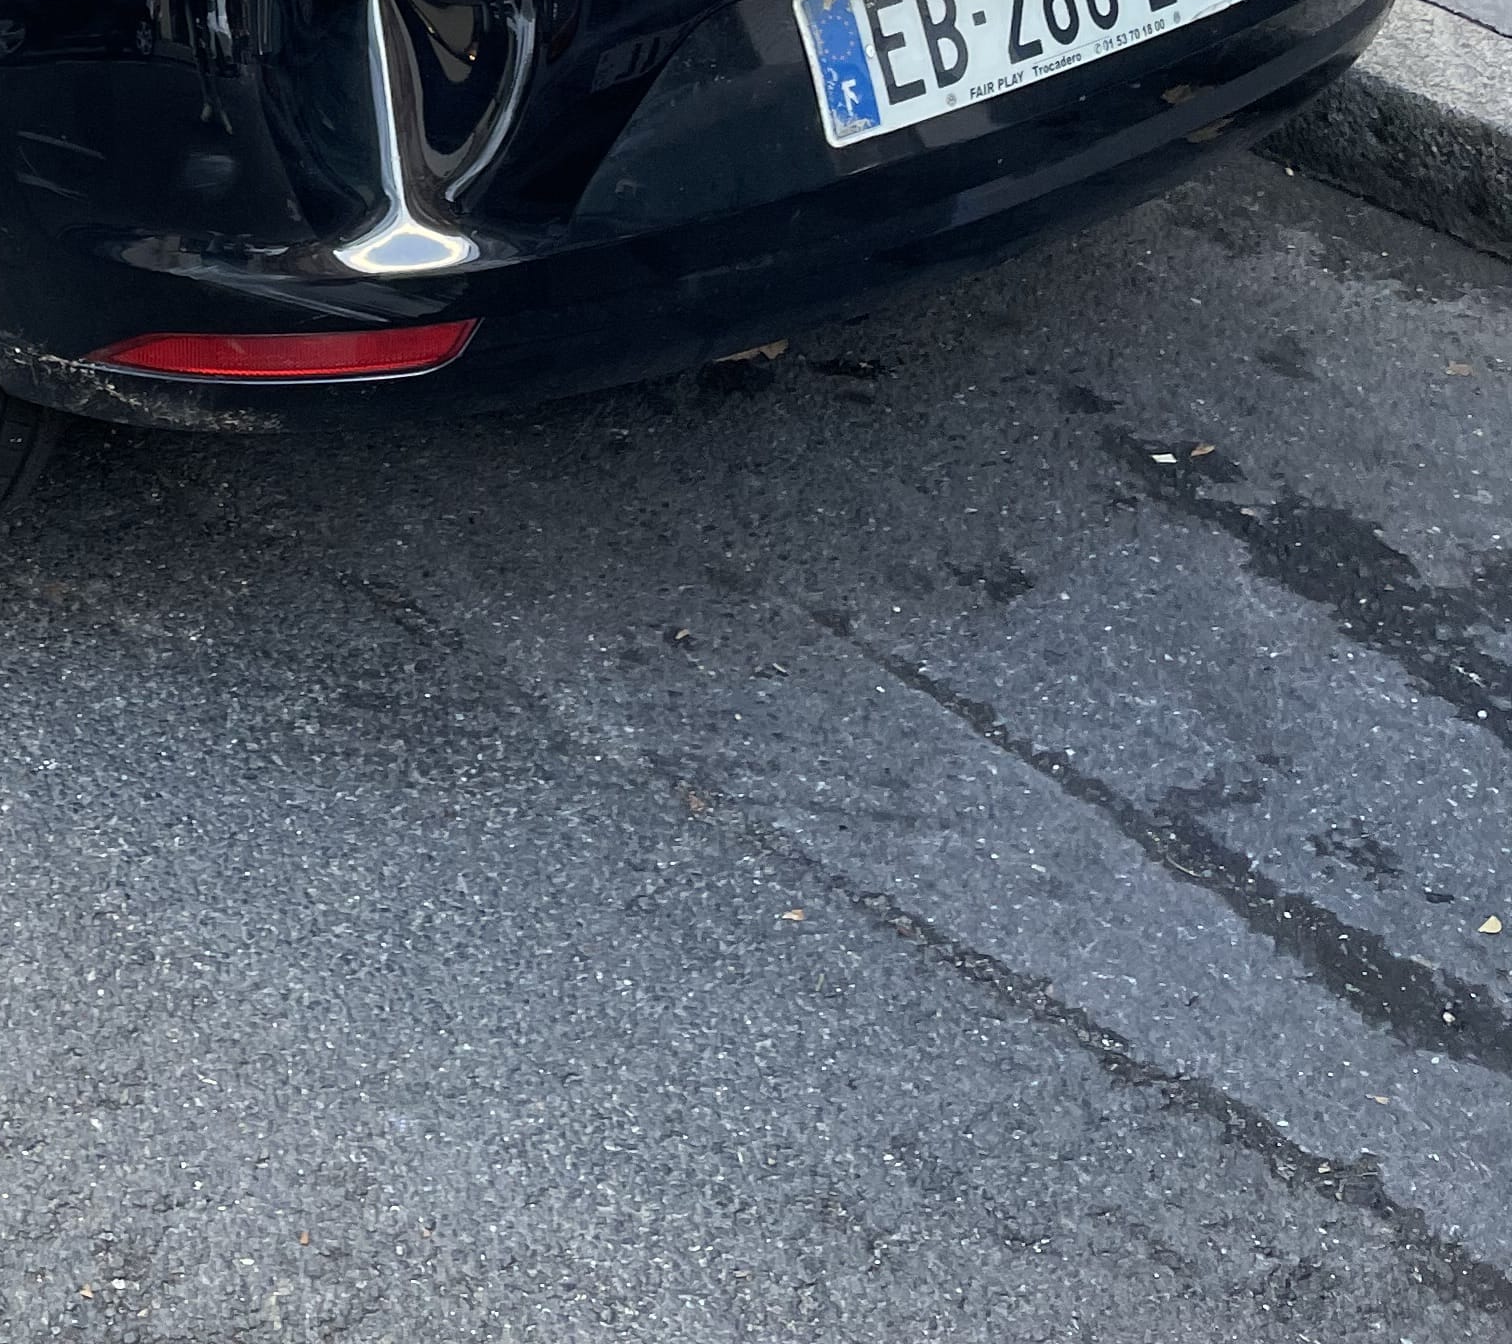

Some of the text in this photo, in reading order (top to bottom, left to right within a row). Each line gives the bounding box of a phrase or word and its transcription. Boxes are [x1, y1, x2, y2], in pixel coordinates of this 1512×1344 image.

[969, 81, 995, 100] FAIR
[997, 70, 1025, 91] PLAY
[1032, 52, 1082, 76] Trocadero
[1116, 33, 1128, 46] 53
[1129, 28, 1140, 41] 70
[1154, 18, 1165, 31] 00
[840, 78, 860, 116] F
